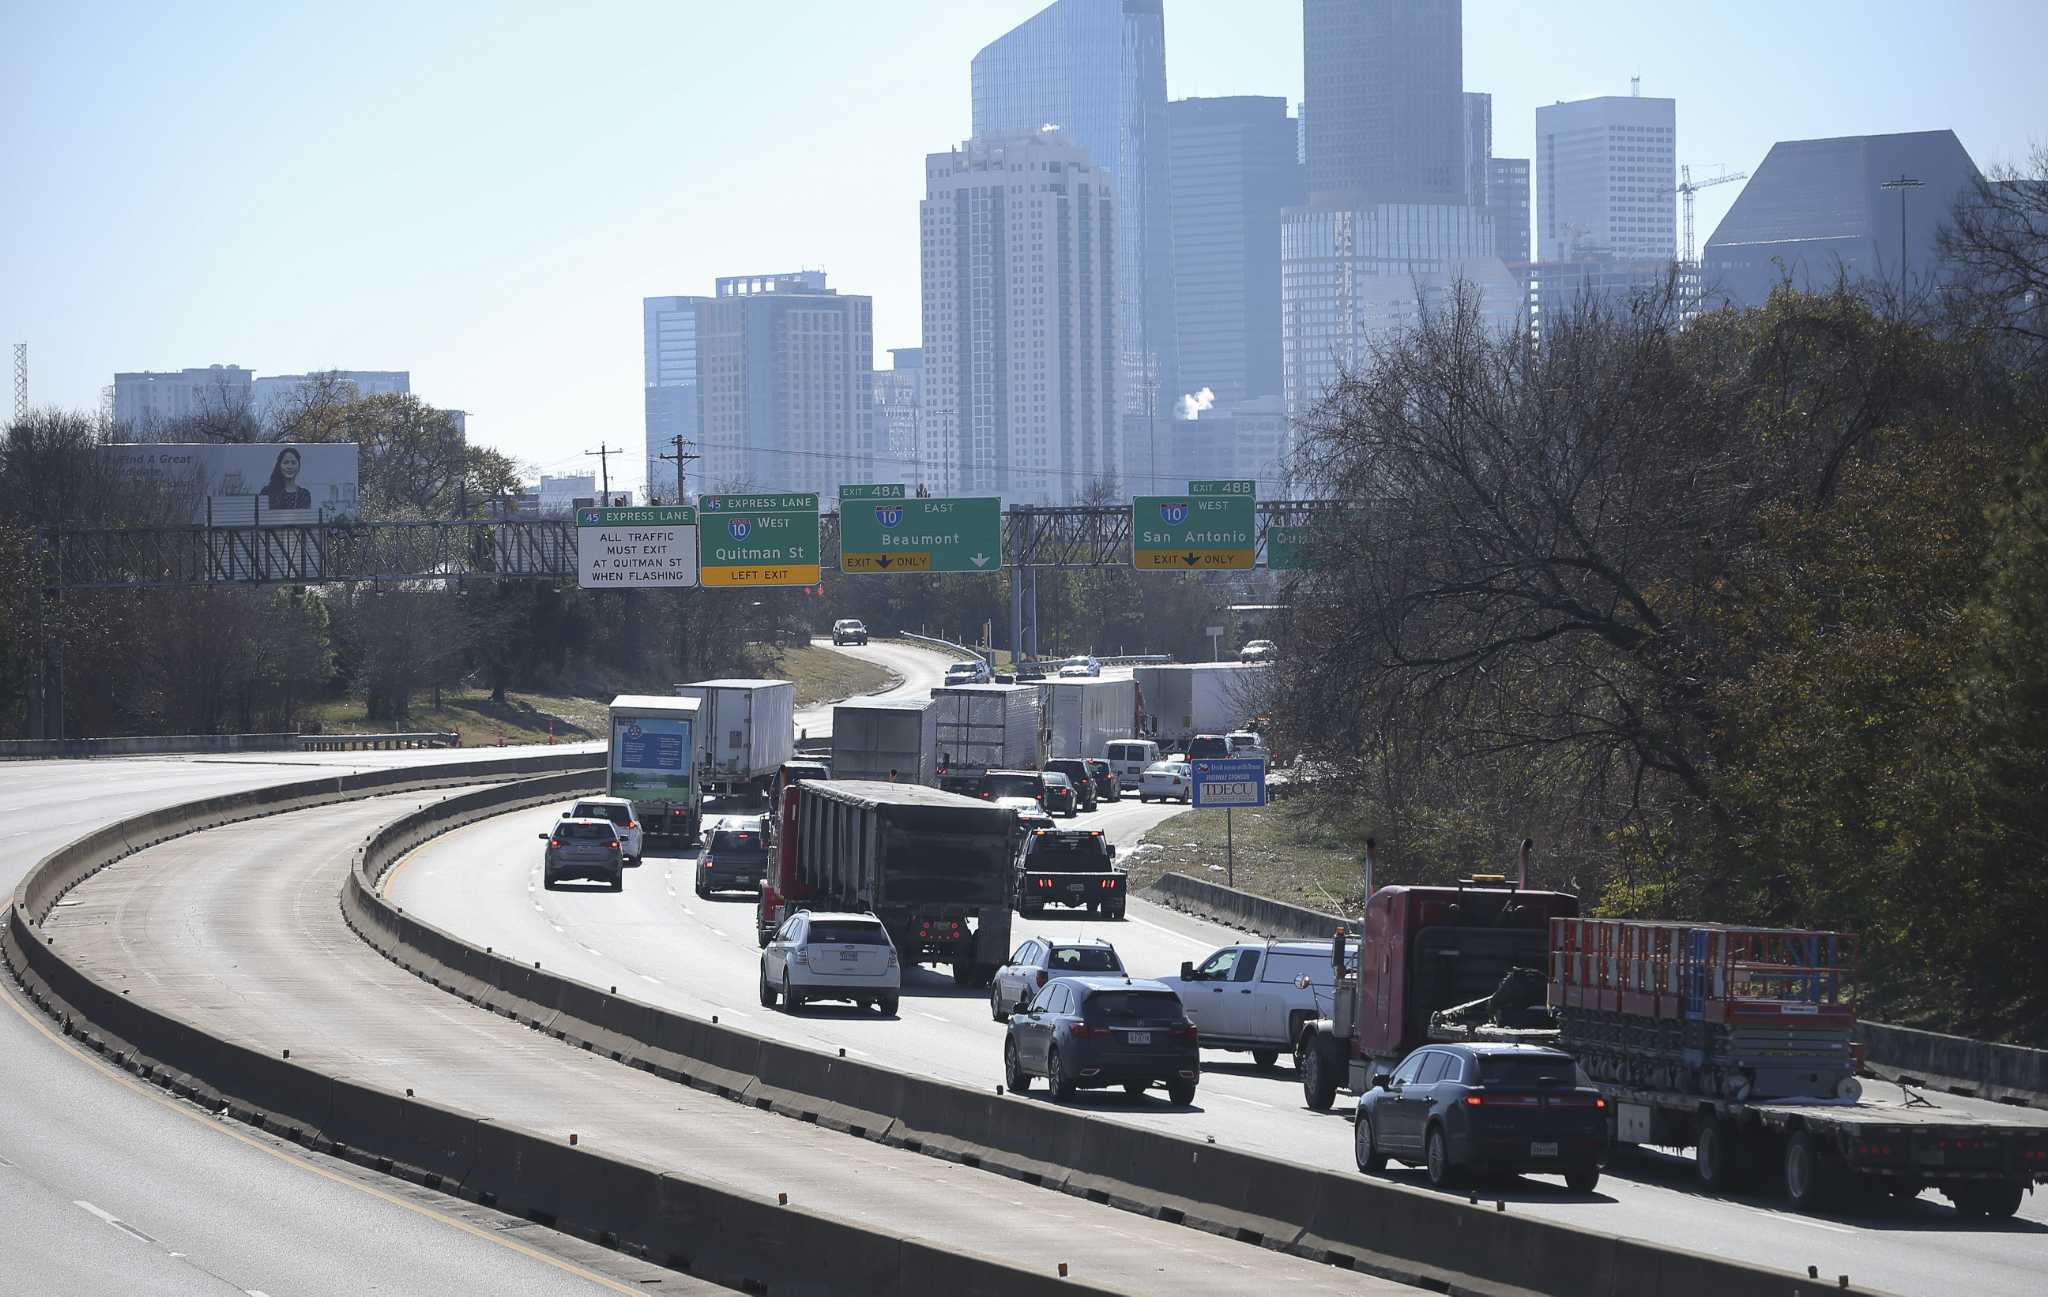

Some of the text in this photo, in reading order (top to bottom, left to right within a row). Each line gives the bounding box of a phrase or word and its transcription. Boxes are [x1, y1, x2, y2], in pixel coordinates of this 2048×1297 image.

[160, 454, 191, 464] Great
[842, 486, 901, 497] EXIT 48A
[1193, 482, 1251, 493] EXIT 48B
[708, 497, 812, 510] 45 EXPRESS LANE
[924, 503, 954, 513] EAST
[1199, 500, 1229, 511] WEST
[586, 511, 689, 522] 45 EXPRESS LANE
[882, 511, 897, 524] 10
[1166, 508, 1181, 521] 10
[733, 523, 746, 536] 10
[600, 532, 674, 542] ALL TRAFFIC
[882, 533, 960, 546] Beaumont
[1143, 531, 1246, 543] San Antonio
[607, 545, 668, 555] MUST EXIT
[715, 546, 804, 561] Quitman St
[593, 558, 682, 568] AT QUITMAN ST
[847, 556, 927, 568] EXIT ONLY
[1154, 554, 1235, 565] EXIT ONLY
[592, 571, 683, 581] WHEN FLASHING
[731, 570, 789, 580] LEFT EXIT
[1202, 782, 1253, 796] TDECU
